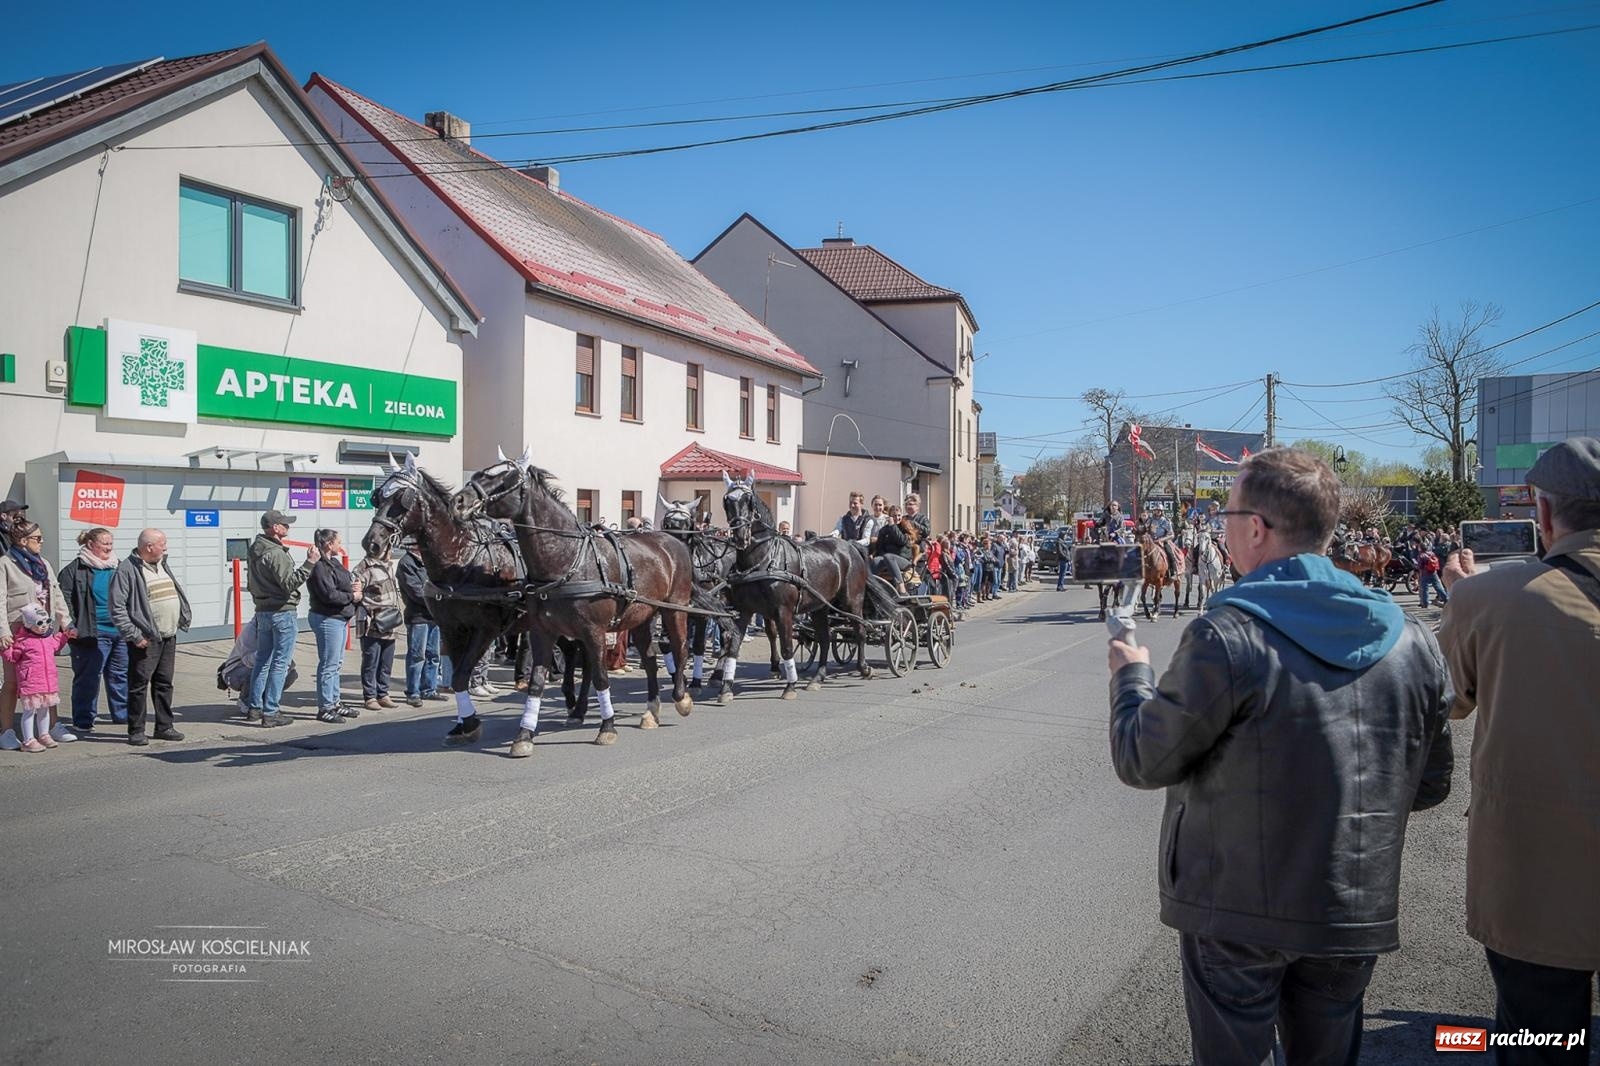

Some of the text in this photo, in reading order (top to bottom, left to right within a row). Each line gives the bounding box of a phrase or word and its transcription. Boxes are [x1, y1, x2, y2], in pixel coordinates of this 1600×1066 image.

[215, 367, 446, 420] APTEKA ZIELONA
[77, 488, 118, 499] ORLEN
[78, 500, 118, 511] paczka
